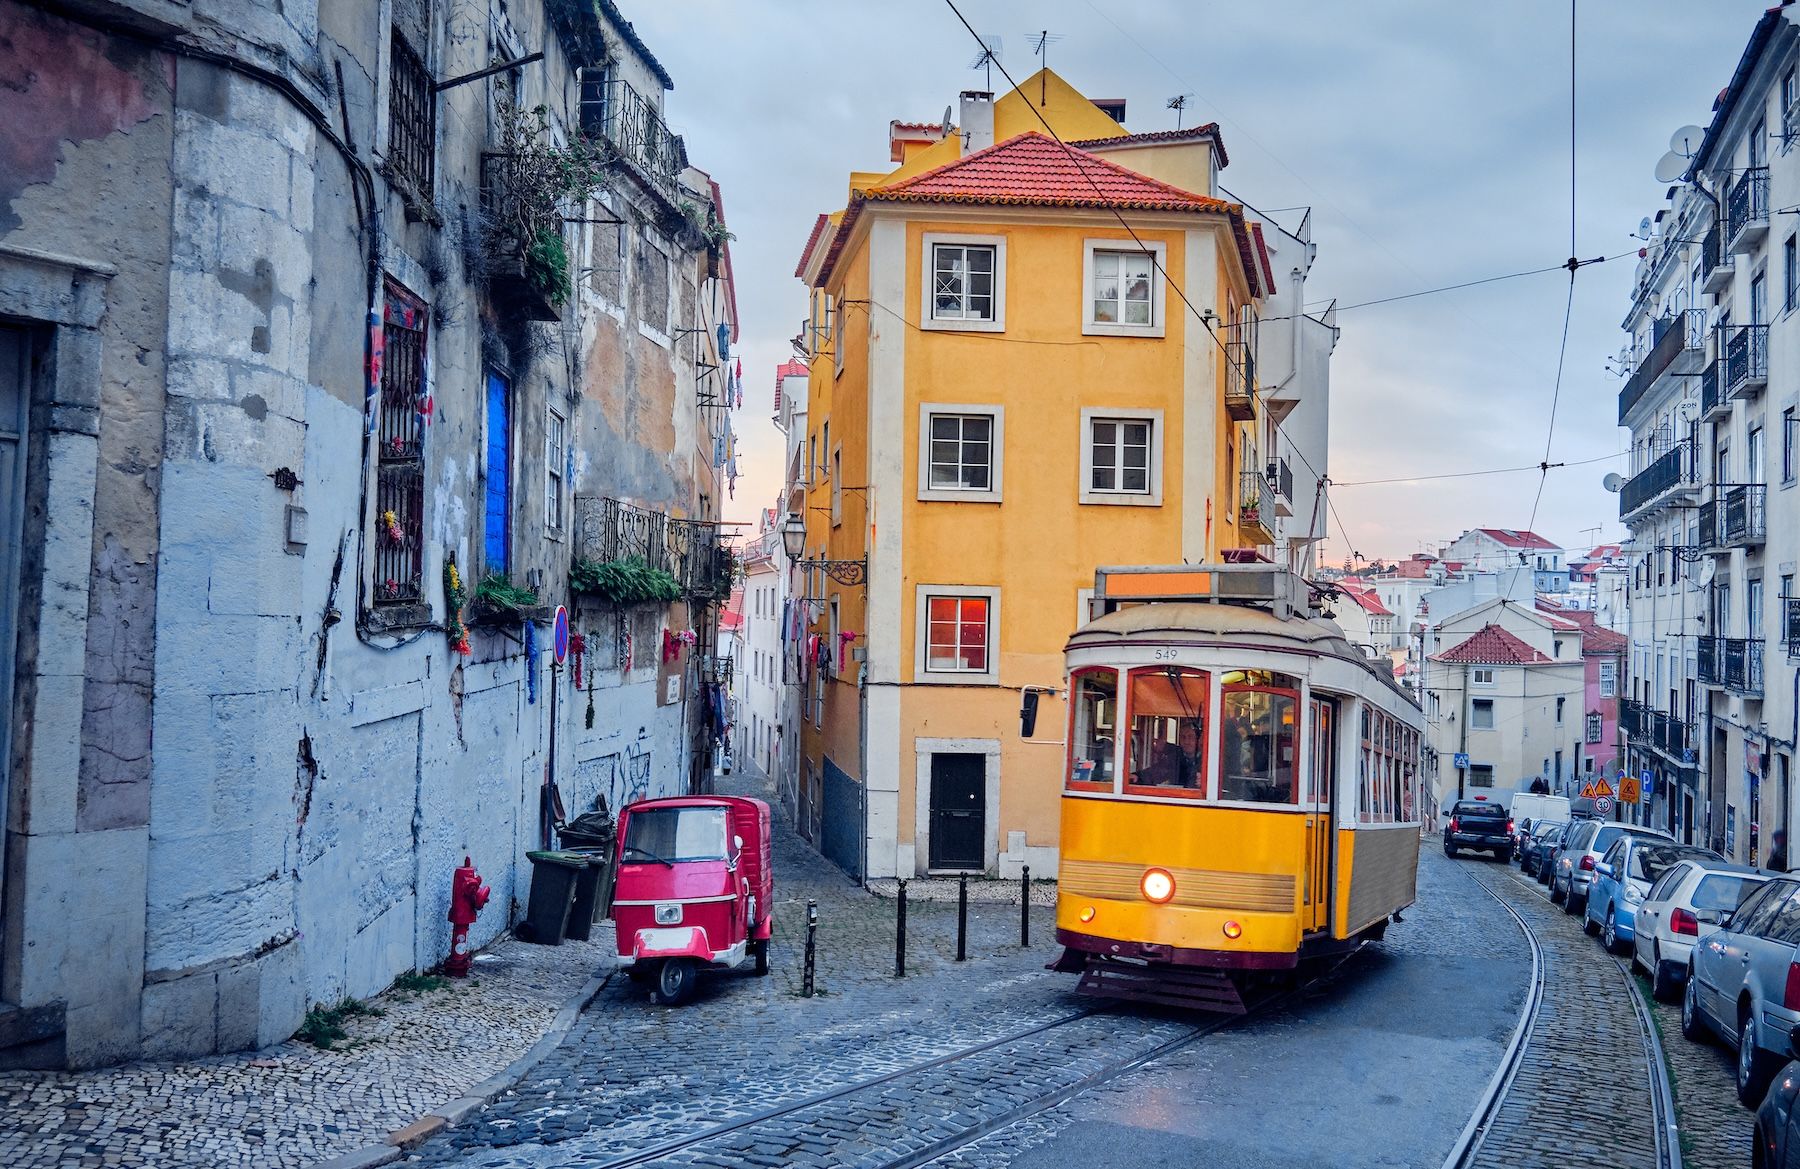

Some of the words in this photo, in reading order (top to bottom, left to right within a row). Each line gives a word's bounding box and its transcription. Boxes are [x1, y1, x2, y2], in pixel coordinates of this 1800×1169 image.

[1155, 649, 1178, 660] 549
[1643, 772, 1651, 790] P
[1597, 801, 1609, 809] 30
